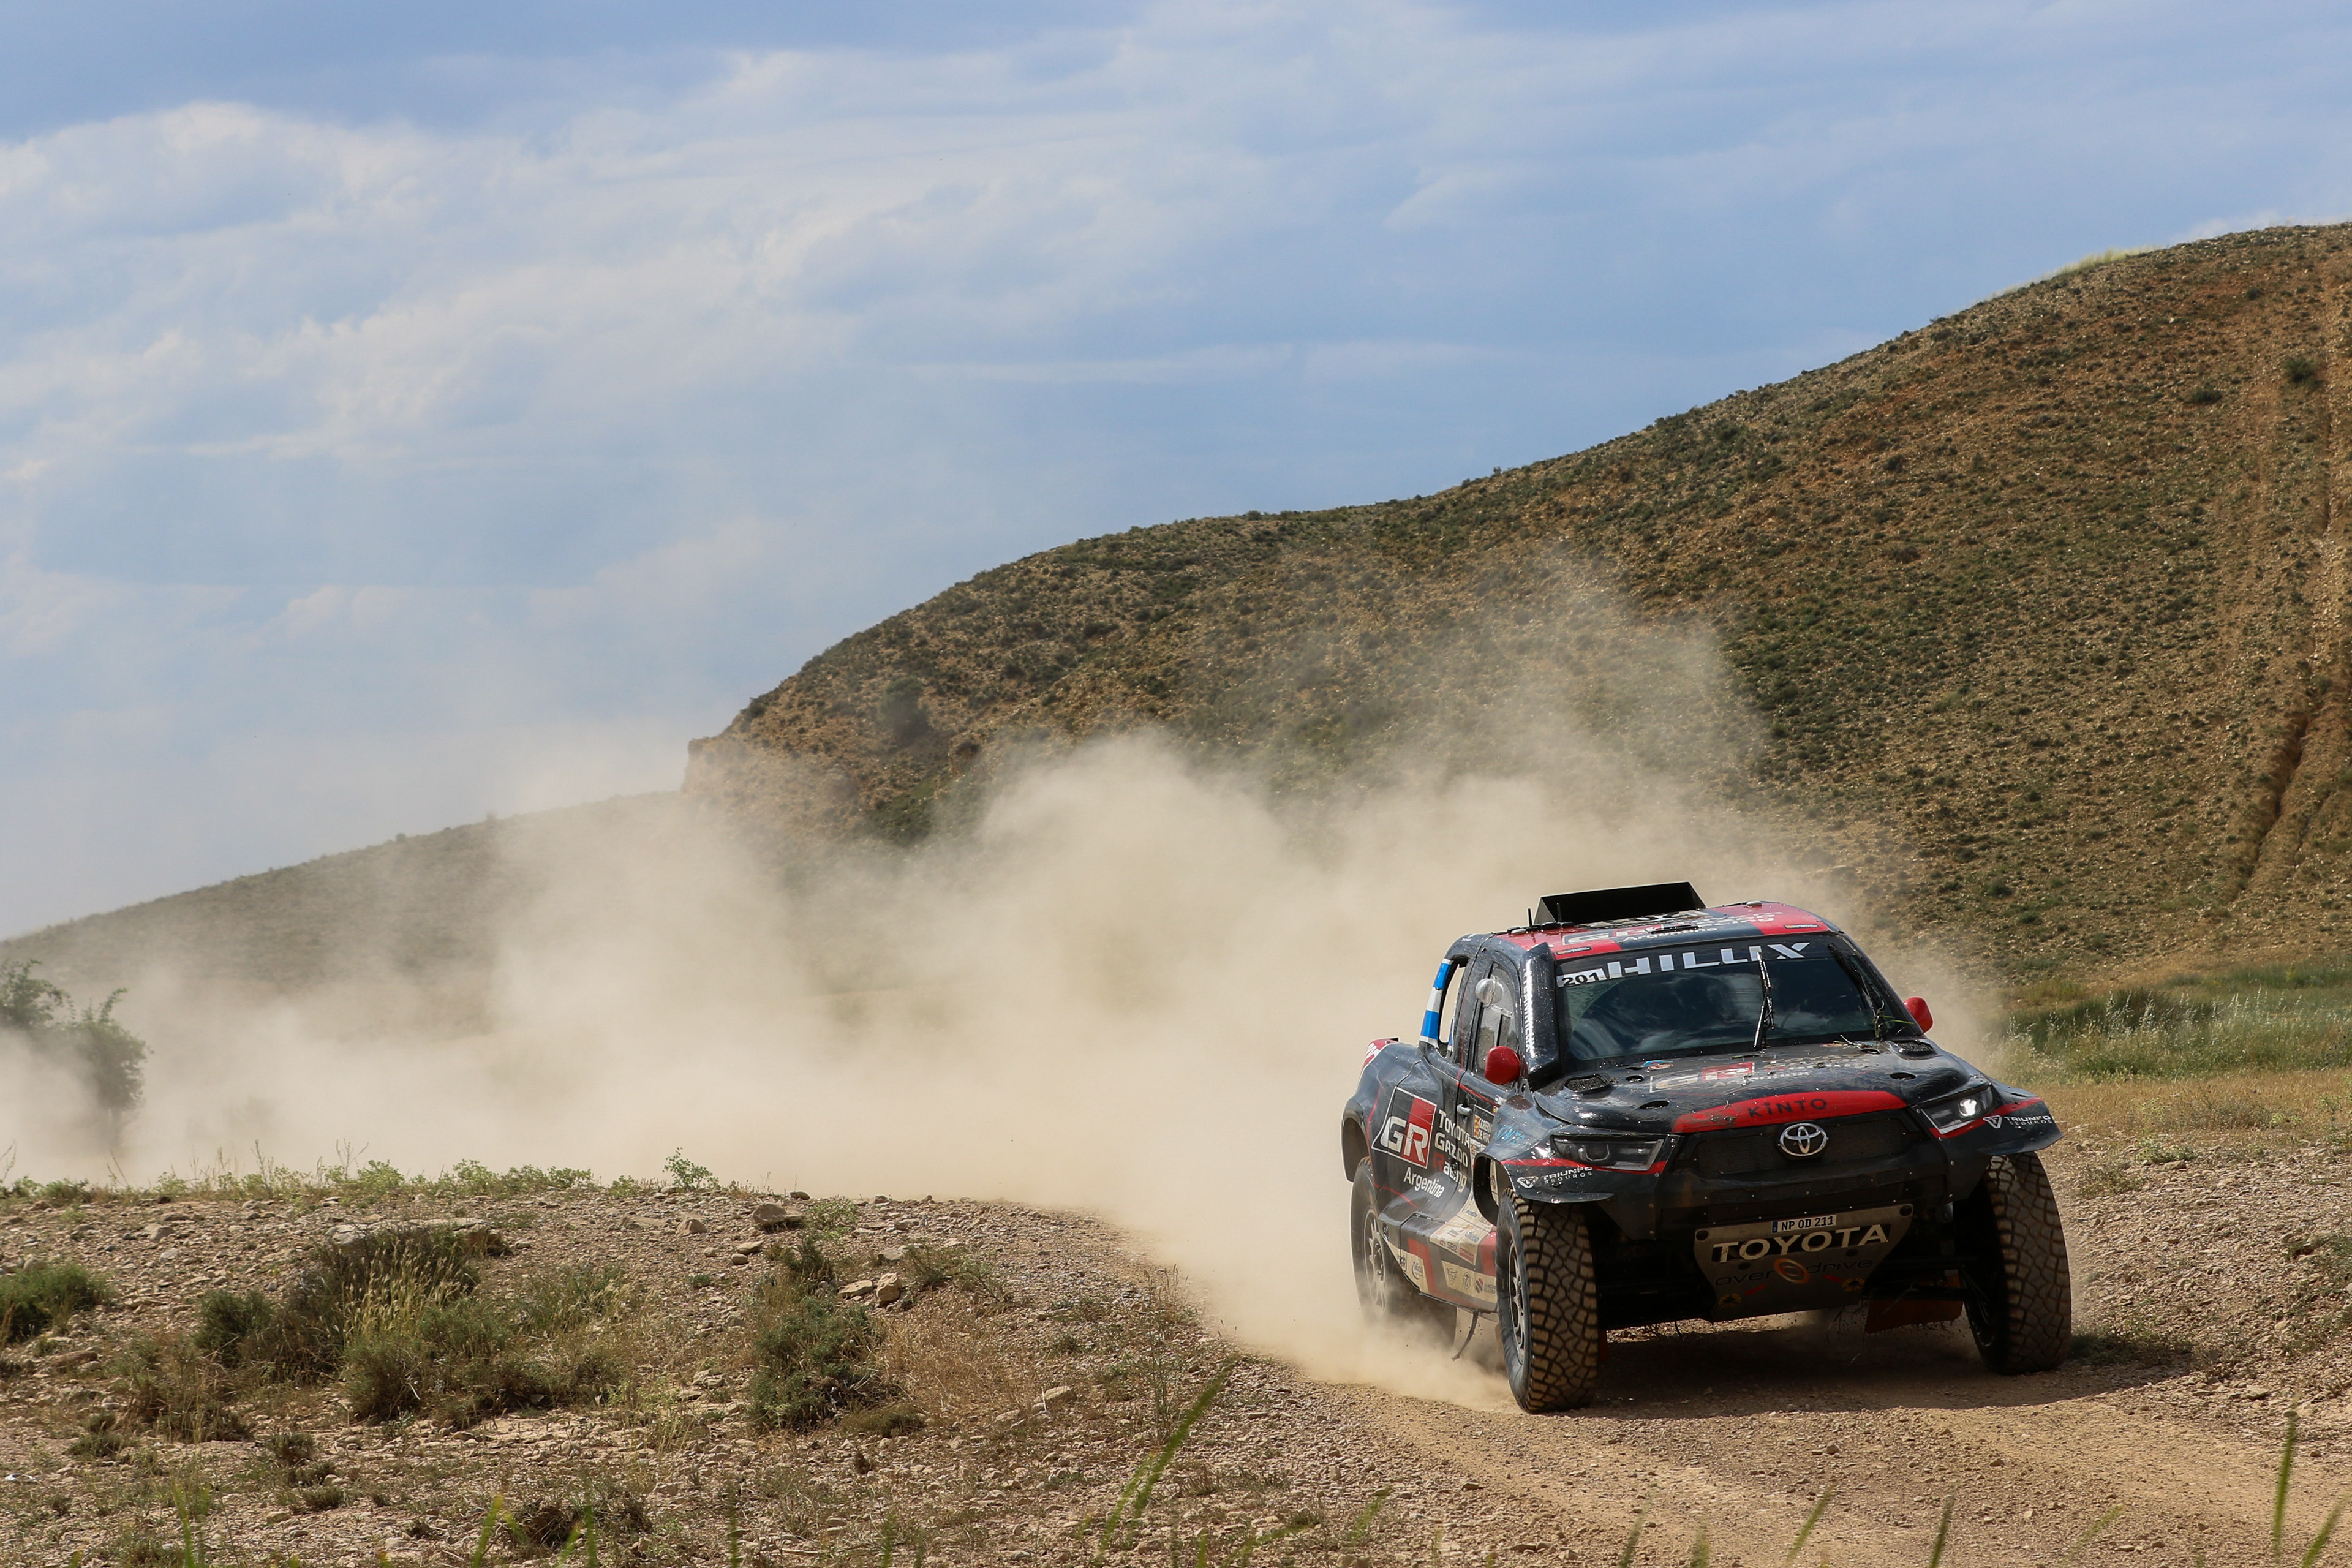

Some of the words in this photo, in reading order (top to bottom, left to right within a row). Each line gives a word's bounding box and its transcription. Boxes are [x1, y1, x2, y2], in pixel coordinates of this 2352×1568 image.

[1607, 942, 1810, 979] HILUX
[1563, 972, 1602, 986] 201
[1748, 1098, 1828, 1118] KINTO
[1379, 1115, 1429, 1163] GR
[1438, 1109, 1471, 1149] TOYOTA
[1434, 1131, 1468, 1168] GAZOO
[1403, 1166, 1446, 1199] Argentina
[1543, 1166, 1593, 1180] TRIUNFO
[1781, 1221, 1795, 1231] NP
[1814, 1216, 1834, 1227] 211
[1713, 1224, 1888, 1264] TOYOTA
[1715, 1269, 1774, 1286] over
[1808, 1259, 1874, 1275] drive
